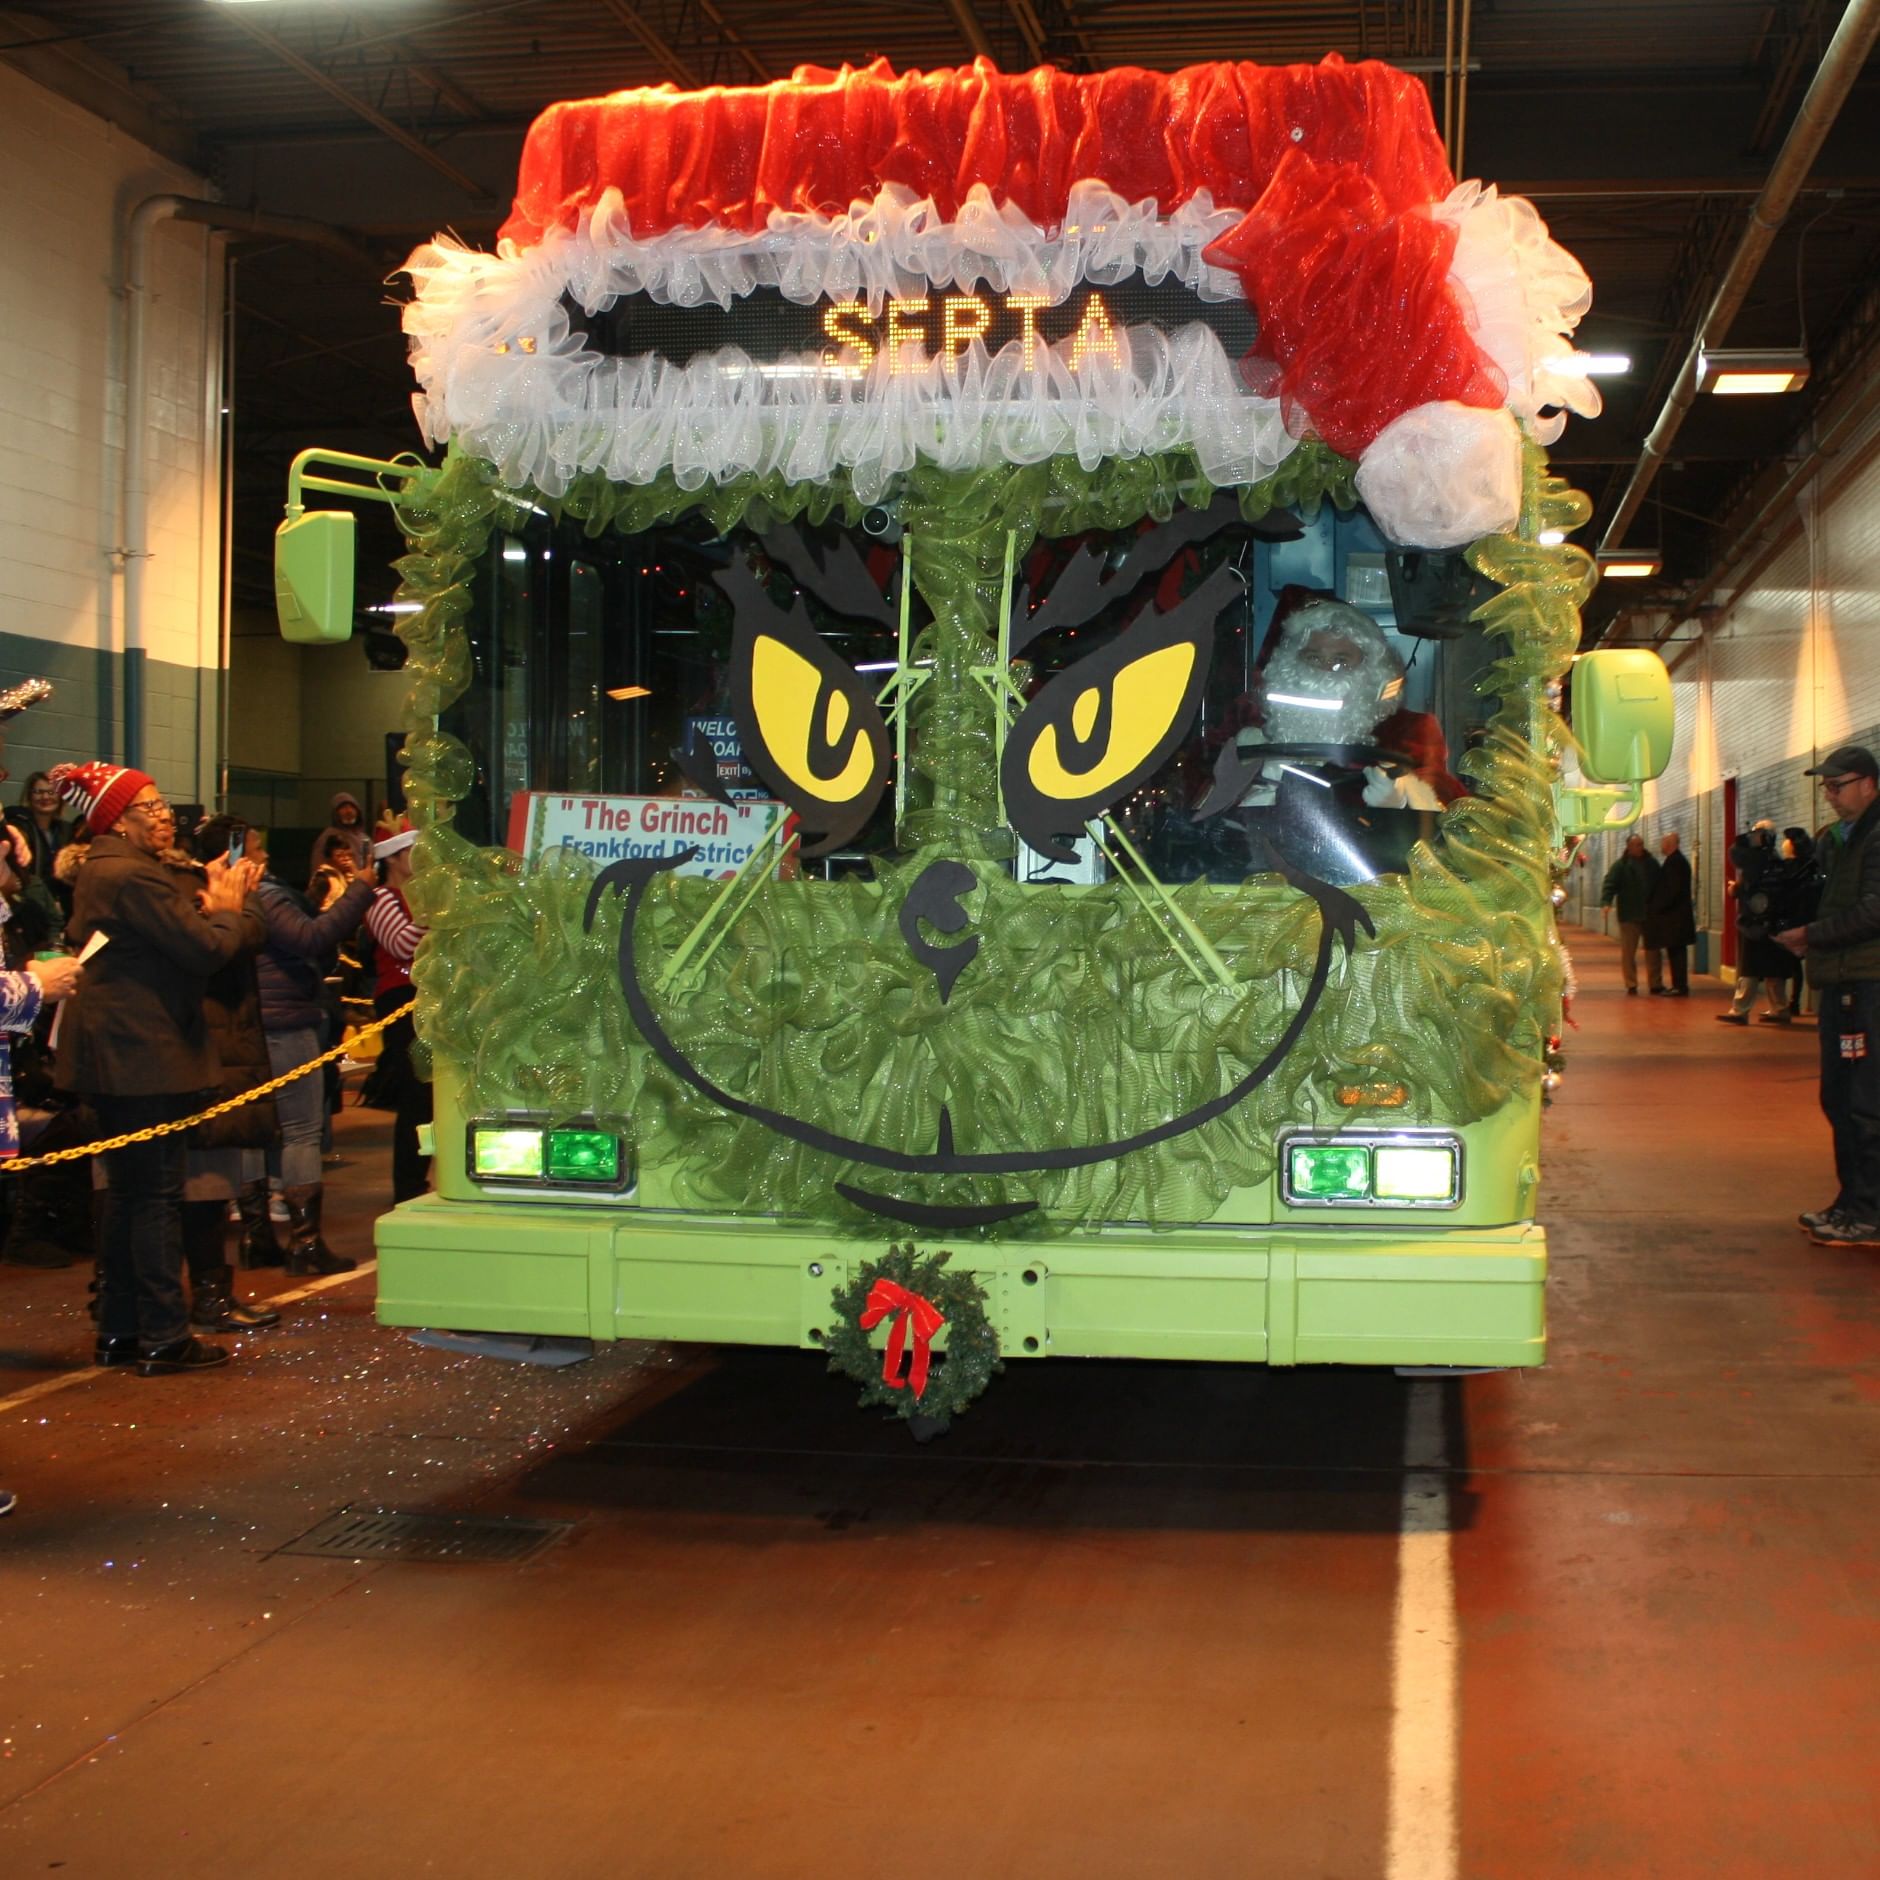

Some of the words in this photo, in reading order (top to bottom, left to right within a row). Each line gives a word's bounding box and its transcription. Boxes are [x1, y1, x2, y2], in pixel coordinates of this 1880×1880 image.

[824, 294, 1121, 378] SEPTA
[692, 721, 737, 736] WELC
[719, 766, 738, 776] EXIT
[561, 835, 666, 859] Frankford
[673, 839, 754, 864] Dstrict
